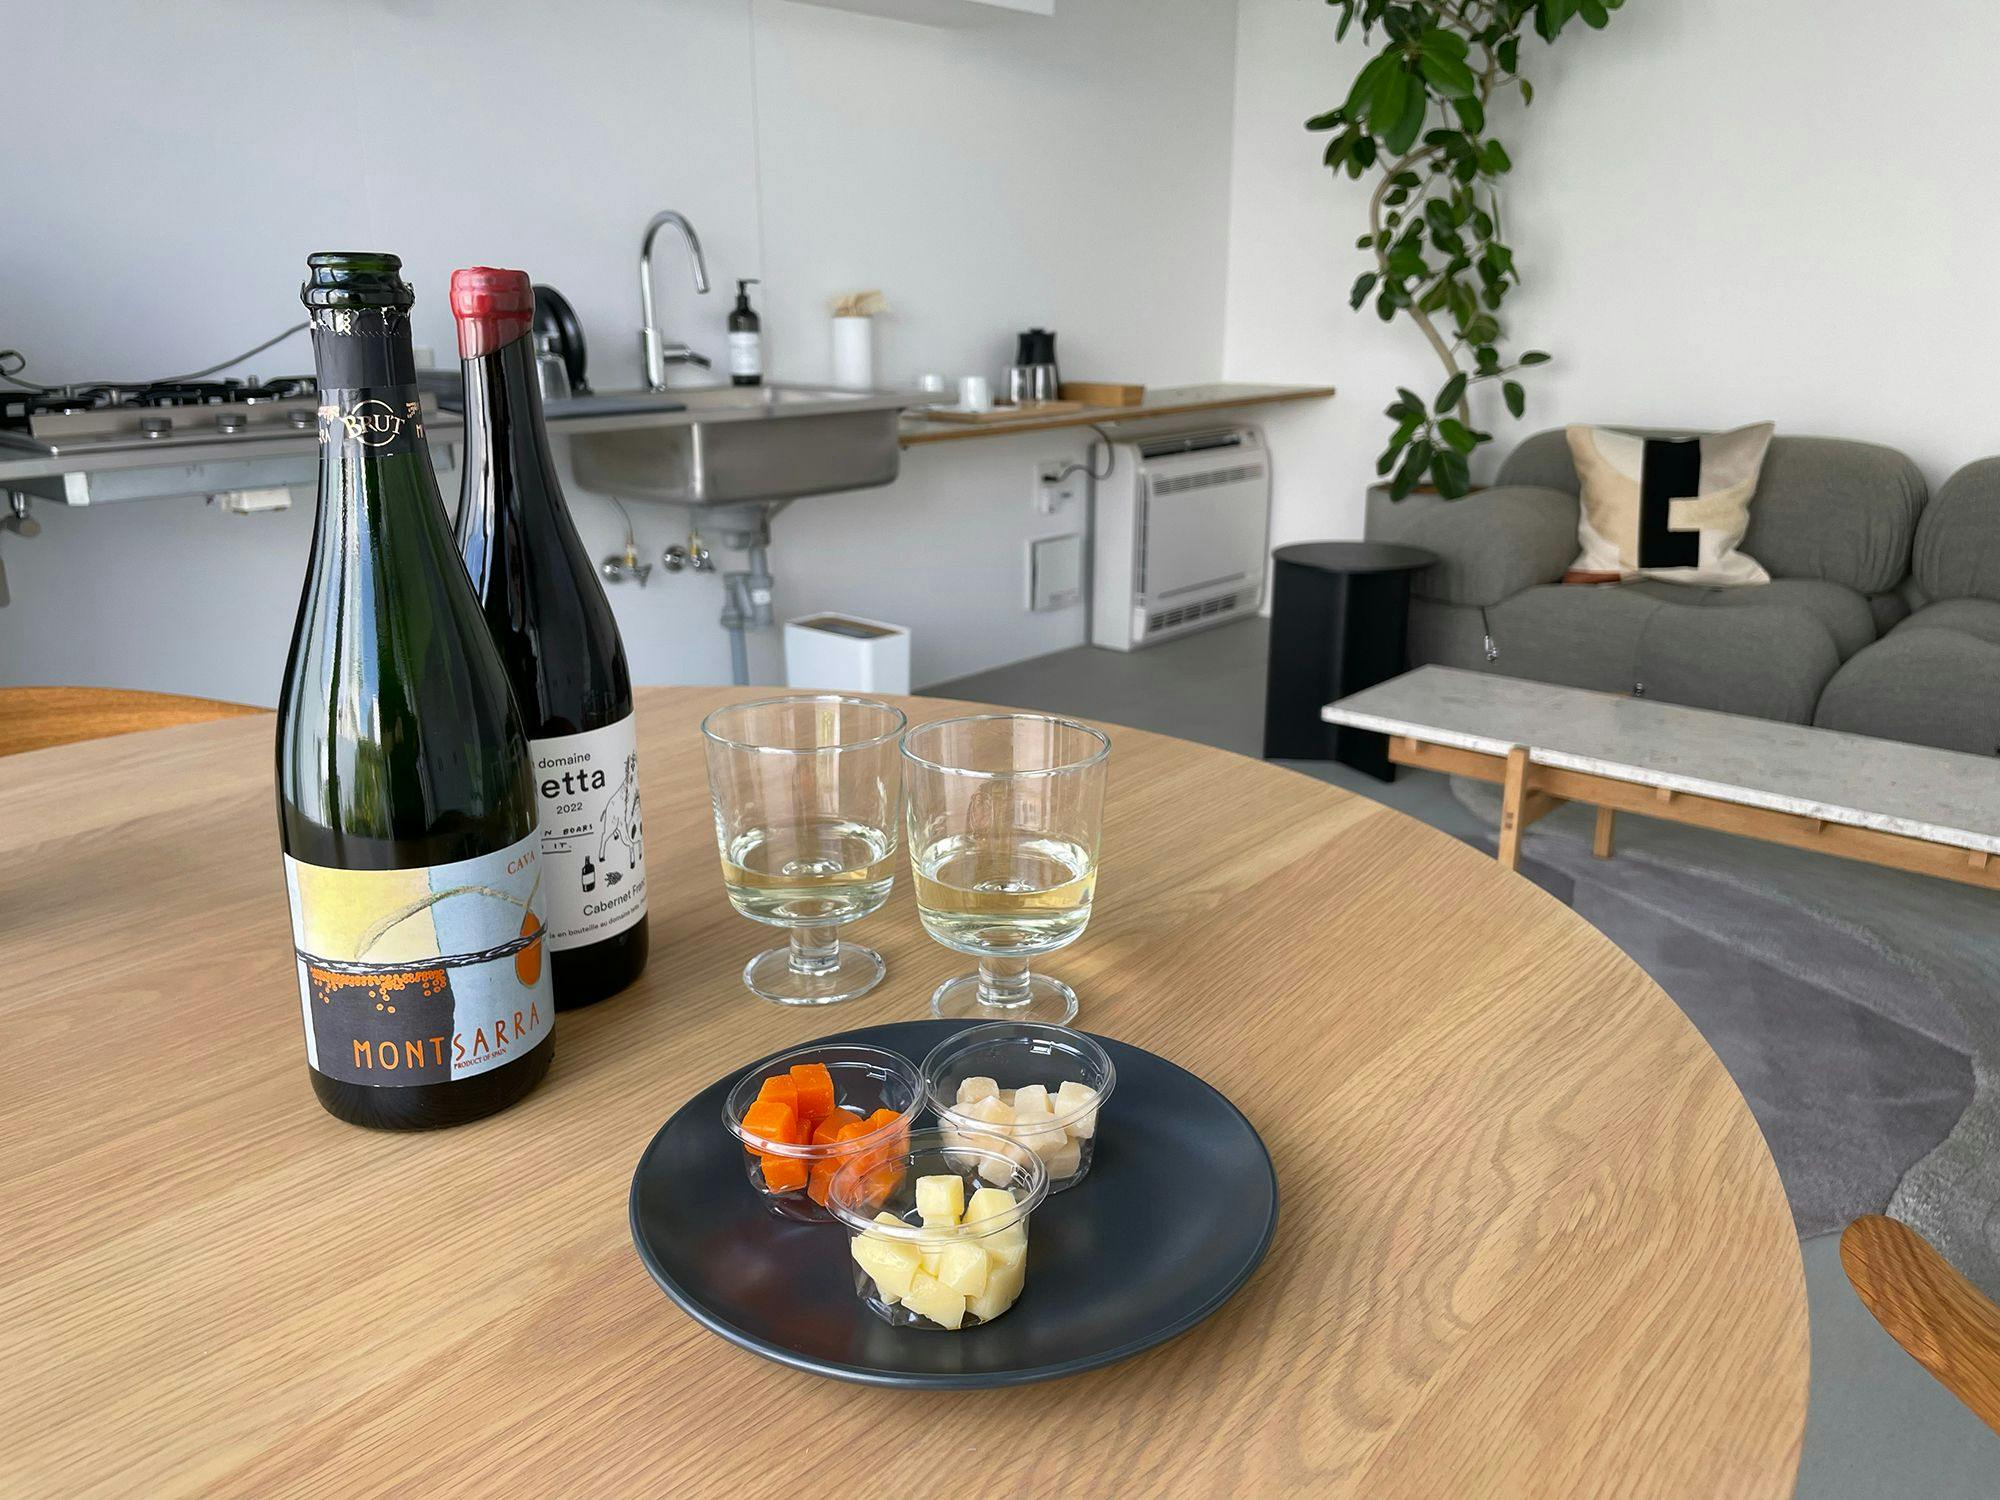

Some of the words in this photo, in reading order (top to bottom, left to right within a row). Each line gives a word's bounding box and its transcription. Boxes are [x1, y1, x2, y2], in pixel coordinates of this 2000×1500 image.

[340, 414, 405, 439] BRUT
[538, 753, 591, 769] domaine
[541, 769, 606, 799] etta
[556, 802, 583, 815] 2022
[563, 823, 593, 835] BOARS
[507, 850, 535, 875] CAVA
[583, 891, 632, 916] Cabernet
[632, 878, 646, 897] Fran
[568, 923, 599, 936] bouteille
[453, 1057, 482, 1069] PRODUCT
[483, 1053, 491, 1062] OF
